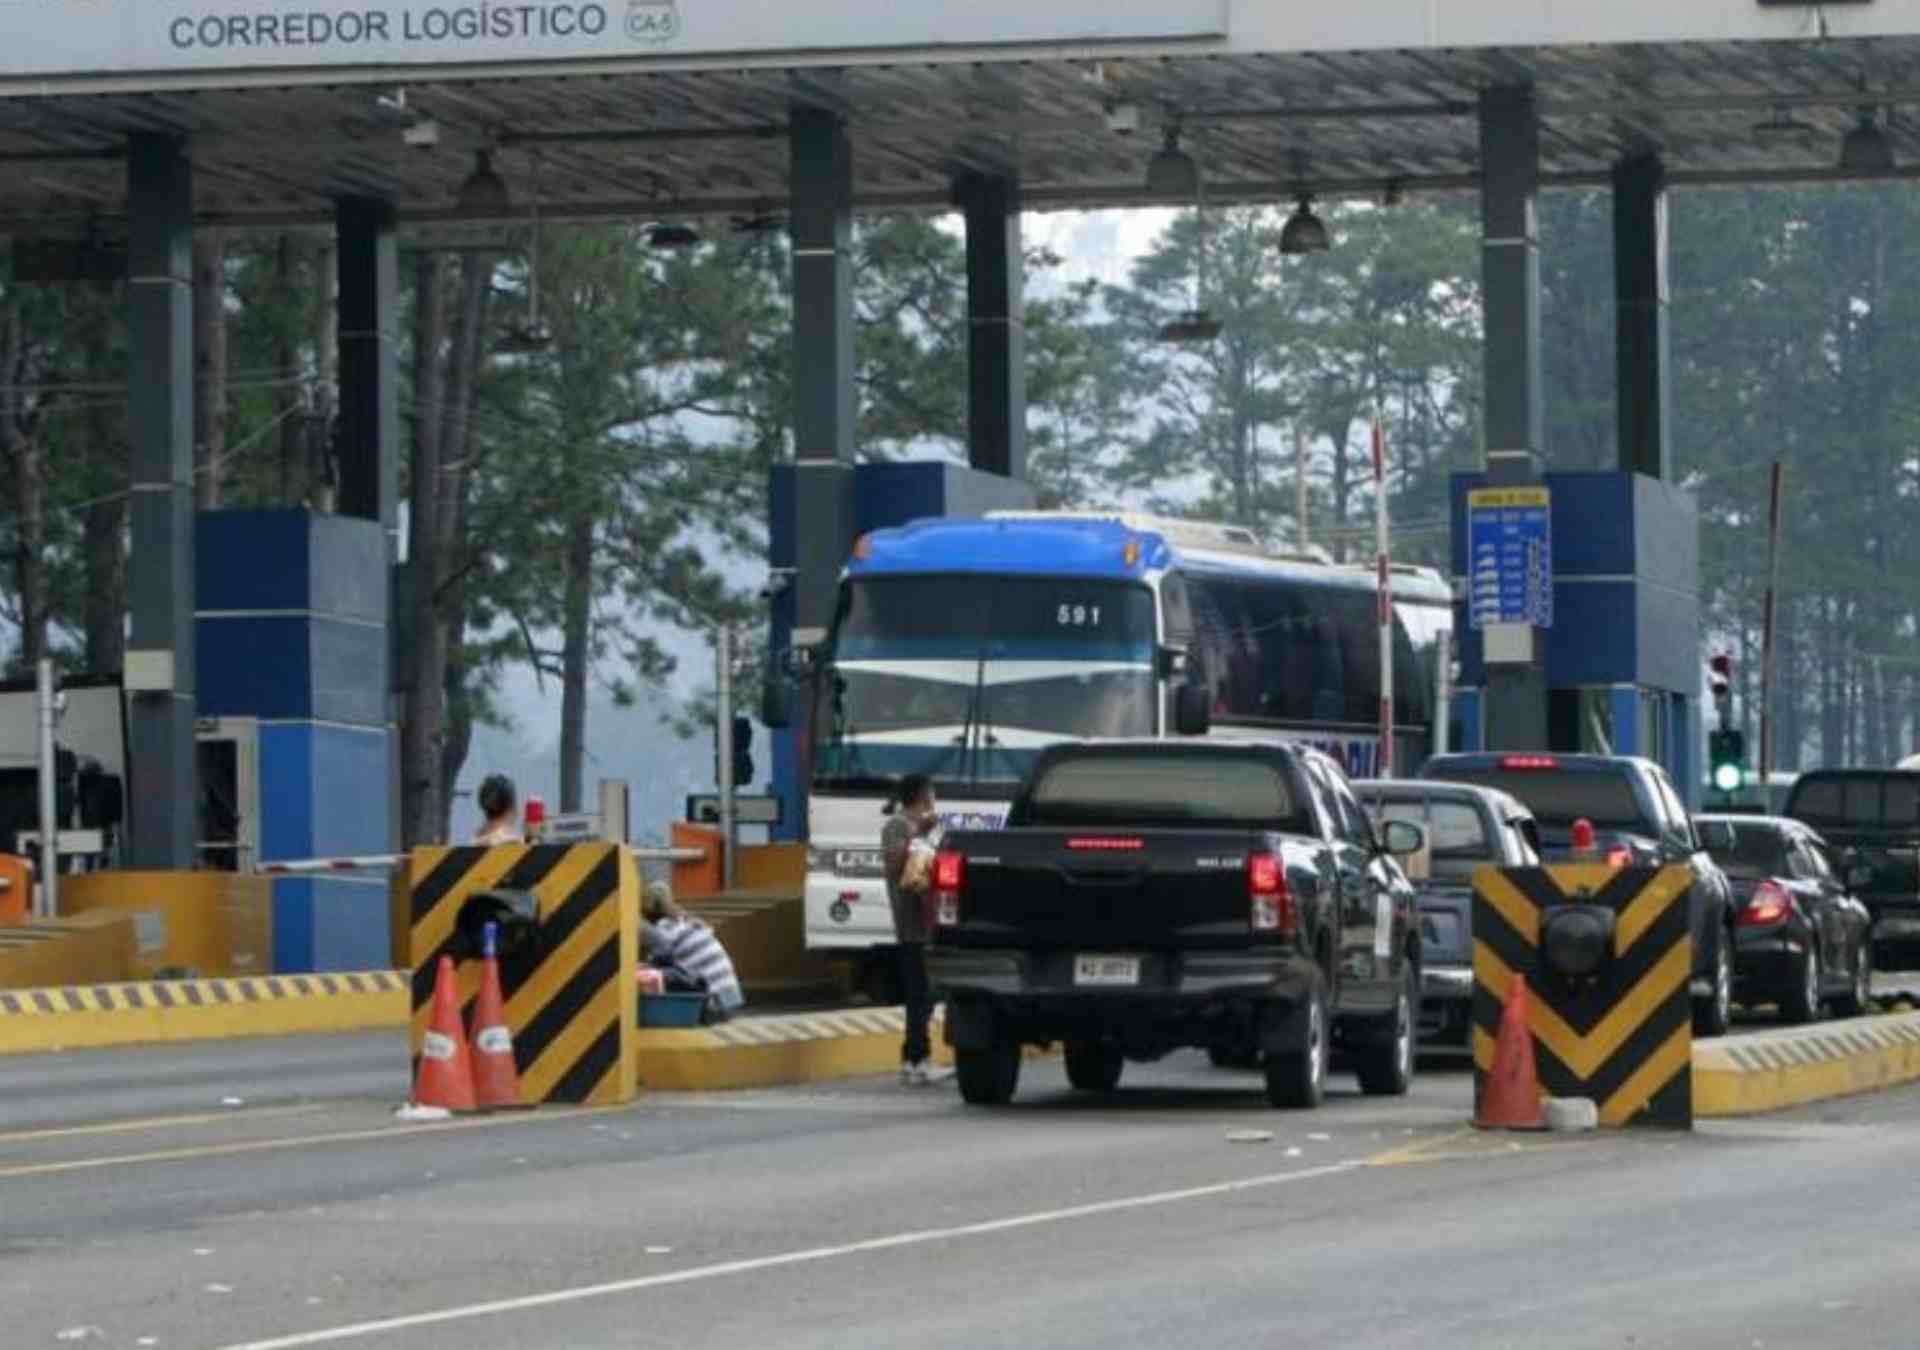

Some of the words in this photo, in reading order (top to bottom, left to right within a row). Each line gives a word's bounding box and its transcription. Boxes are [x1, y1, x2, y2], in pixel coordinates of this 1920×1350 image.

[169, 10, 390, 49] CORREDOR
[402, 0, 606, 40] LOGÍSTICO
[1056, 603, 1100, 625] 591
